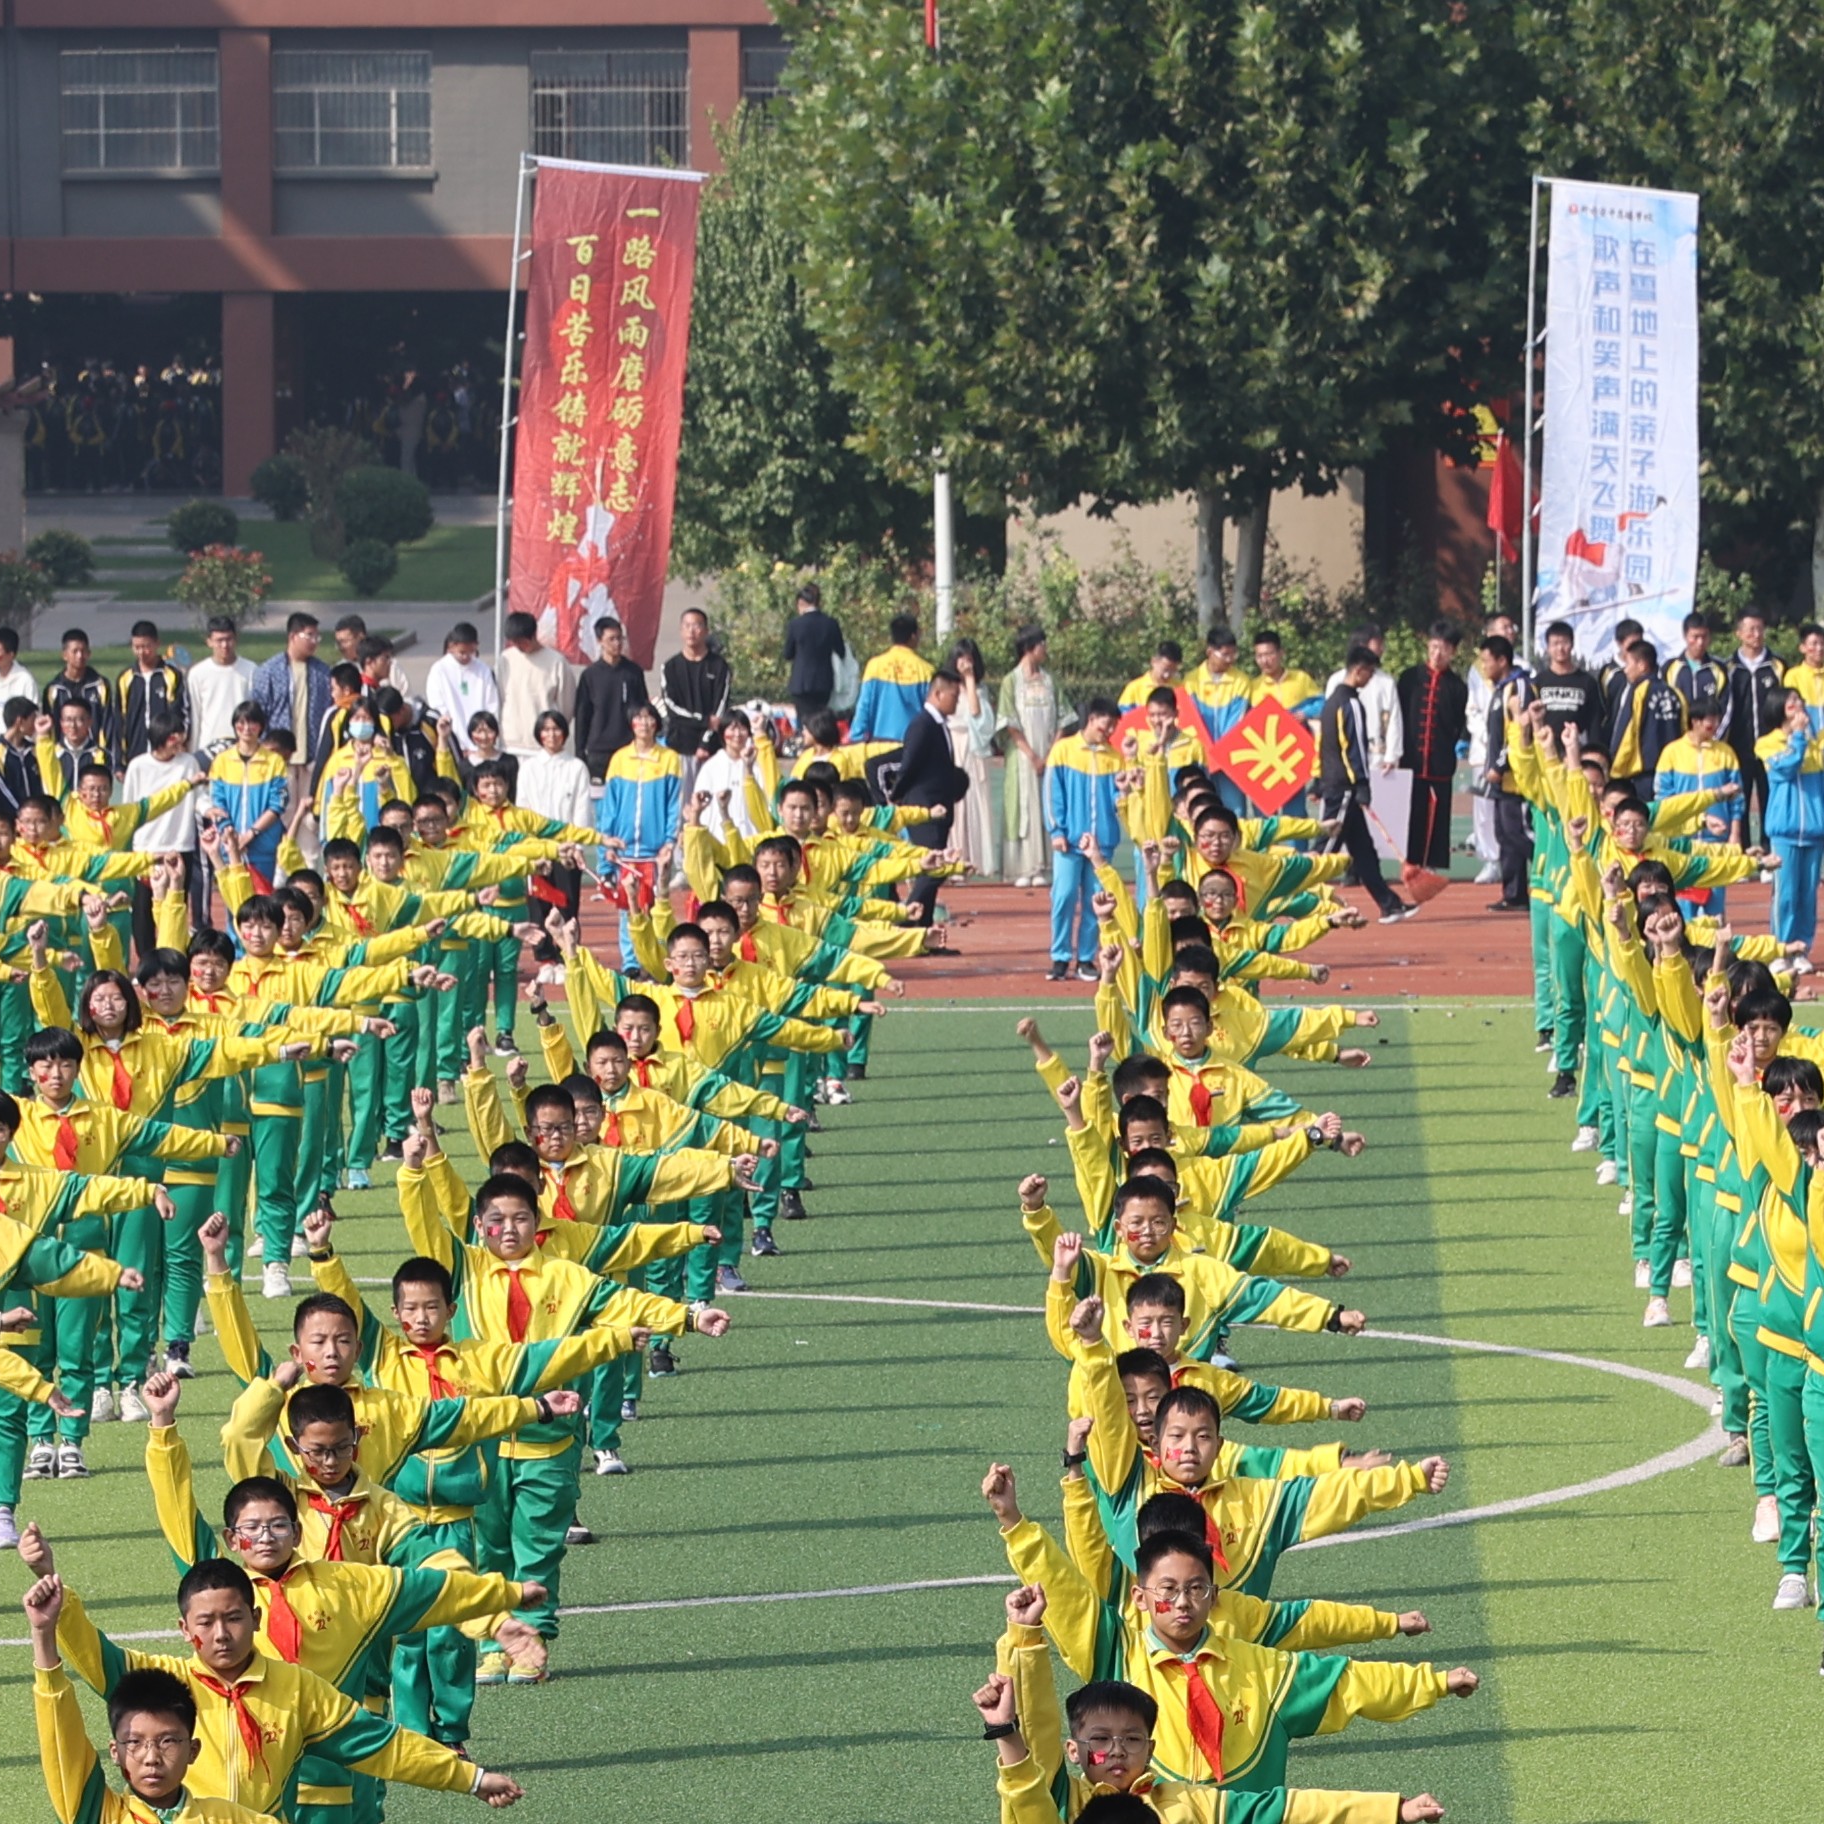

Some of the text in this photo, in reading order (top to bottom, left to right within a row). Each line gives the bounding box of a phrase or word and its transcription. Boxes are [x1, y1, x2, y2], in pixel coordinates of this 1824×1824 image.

[546, 233, 600, 546] 百日苦乐铸就辉煌
[605, 207, 661, 514] 一路风雨磨砺意志
[1589, 233, 1621, 544] 歌声和笑声满天飞舞
[1624, 239, 1658, 585] 在雪地上的亲子游乐园
